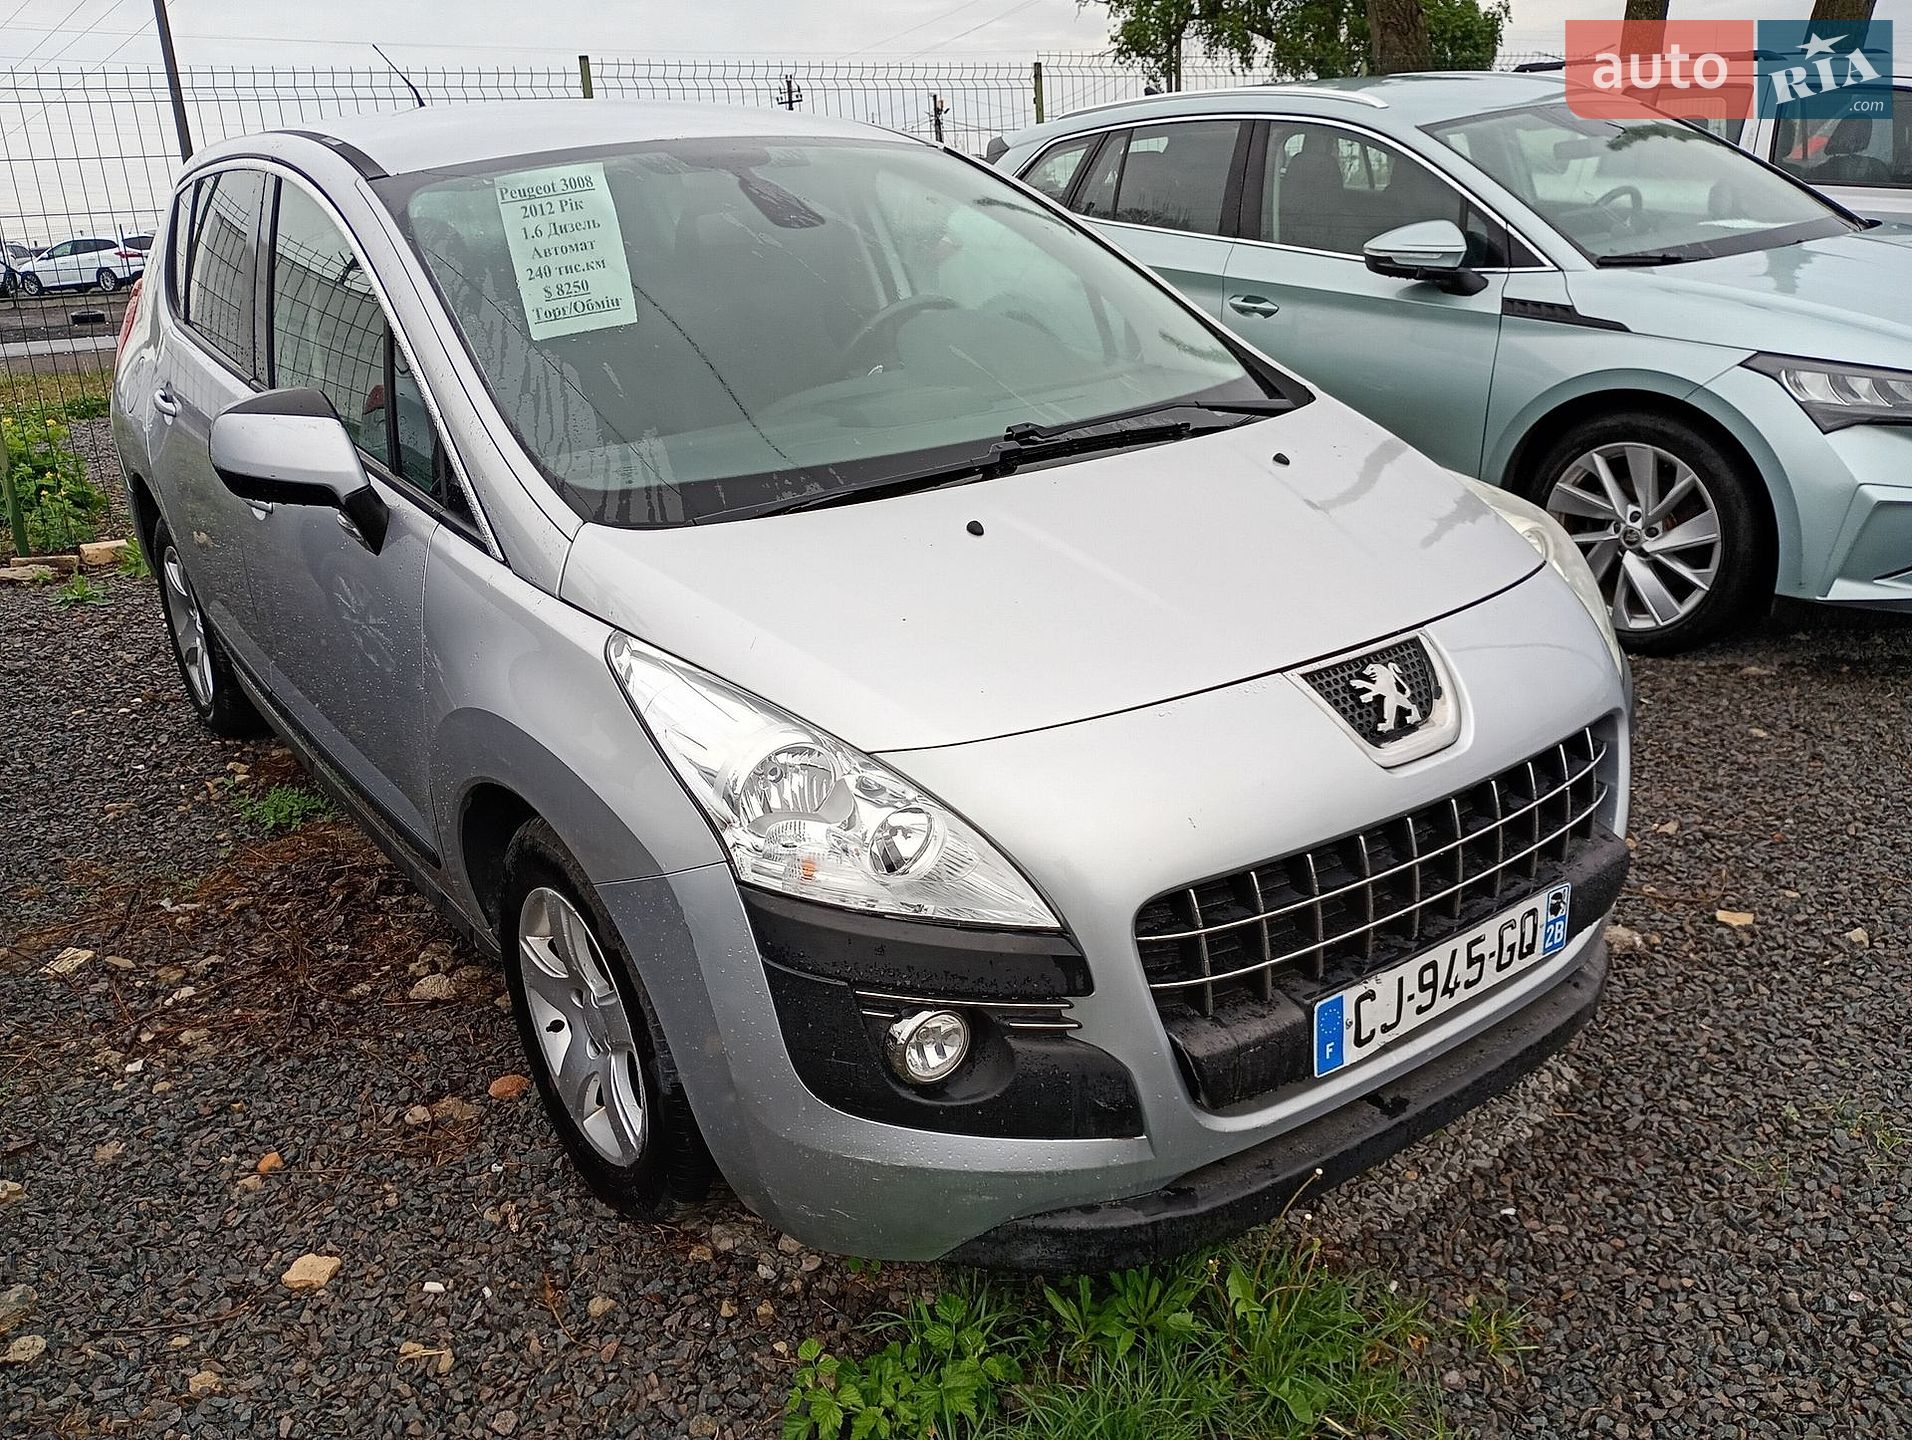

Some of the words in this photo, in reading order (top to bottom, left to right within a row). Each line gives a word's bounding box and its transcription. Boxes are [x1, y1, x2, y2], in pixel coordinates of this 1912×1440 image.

[500, 182, 557, 201] Peugeot
[561, 175, 594, 192] 3008
[520, 202, 556, 219] 2012
[559, 198, 585, 213] Рік
[521, 225, 543, 240] 1.6
[547, 219, 601, 237] Дизель
[532, 240, 596, 259] Автомат
[526, 264, 552, 281] 240
[555, 257, 607, 276] тис.км
[555, 279, 590, 297] 8250
[531, 296, 622, 321] Торг/Обмін
[1325, 1042, 1335, 1059] F
[1353, 907, 1540, 1049] CJ-945-GQ
[1545, 920, 1565, 949] 2B
